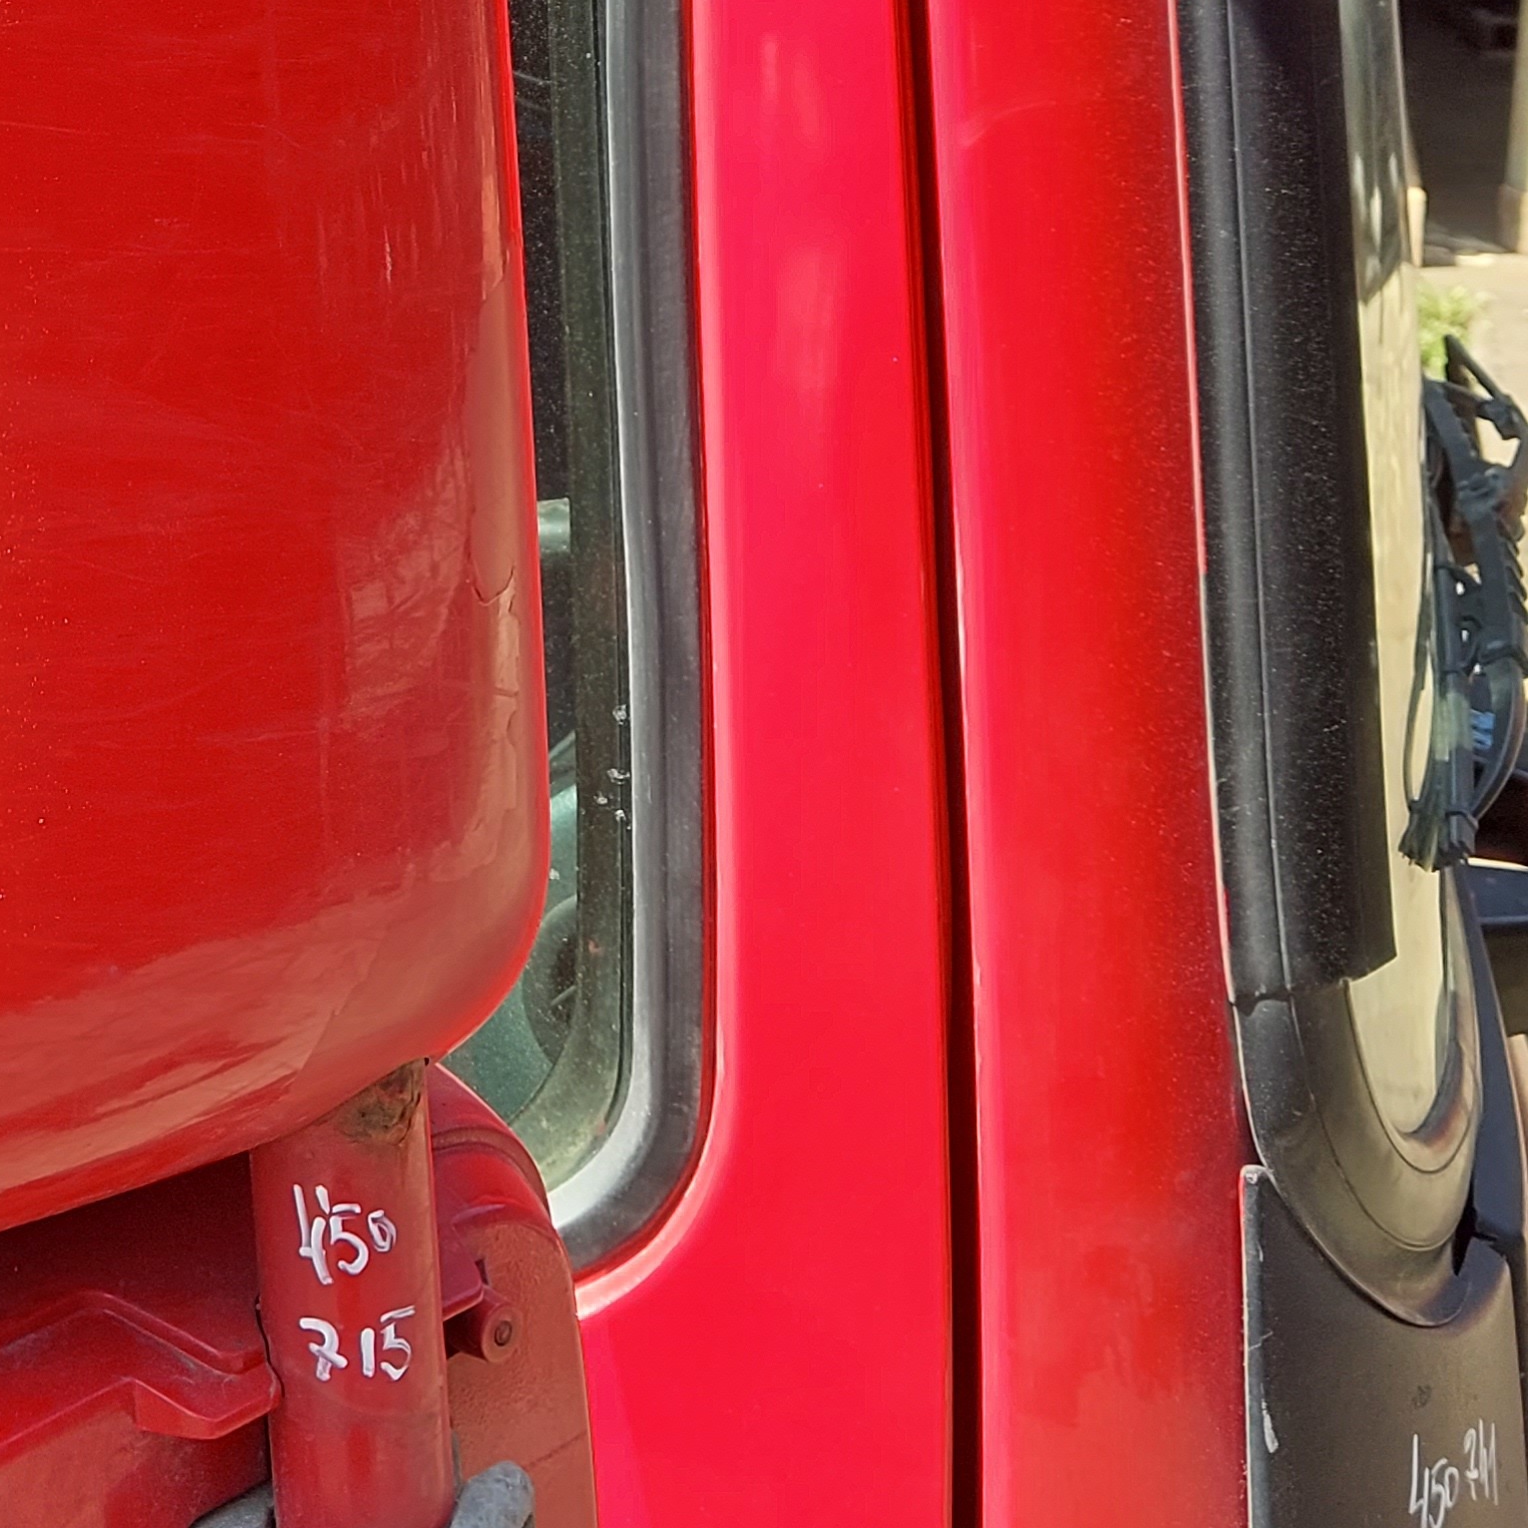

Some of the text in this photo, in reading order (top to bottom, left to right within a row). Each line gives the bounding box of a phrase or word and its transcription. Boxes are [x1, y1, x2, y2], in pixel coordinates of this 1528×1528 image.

[293, 1184, 398, 1285] 450
[298, 1305, 415, 1381] 715
[1408, 1433, 1460, 1528] 450
